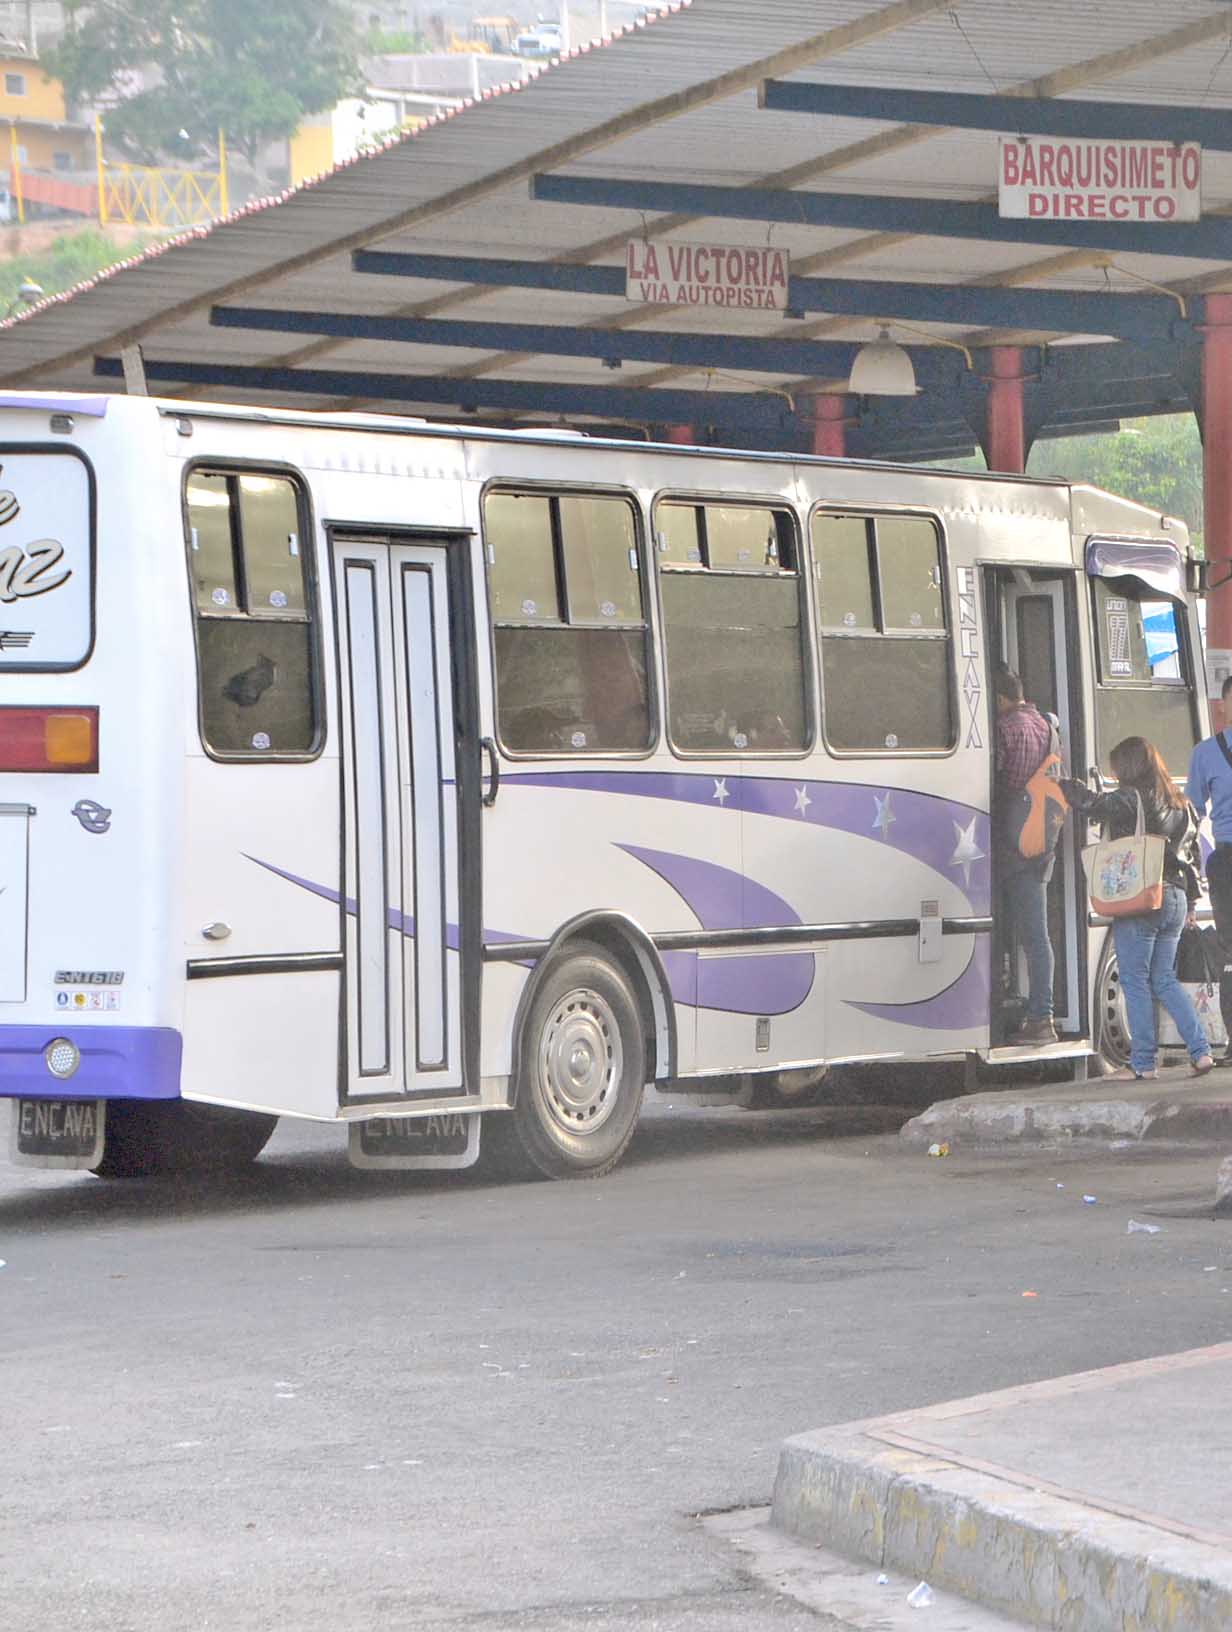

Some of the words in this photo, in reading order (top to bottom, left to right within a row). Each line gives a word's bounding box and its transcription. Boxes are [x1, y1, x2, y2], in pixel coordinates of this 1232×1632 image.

[1003, 143, 1200, 190] BARQUISIMETO
[1028, 193, 1176, 219] DIRECTO
[629, 243, 660, 280] LA
[668, 246, 786, 288] VICTORIA
[640, 282, 670, 302] VIA
[676, 284, 776, 308] AUTOPISTA
[957, 566, 983, 748] ENCAVA
[21, 1101, 95, 1138] ENCAVA
